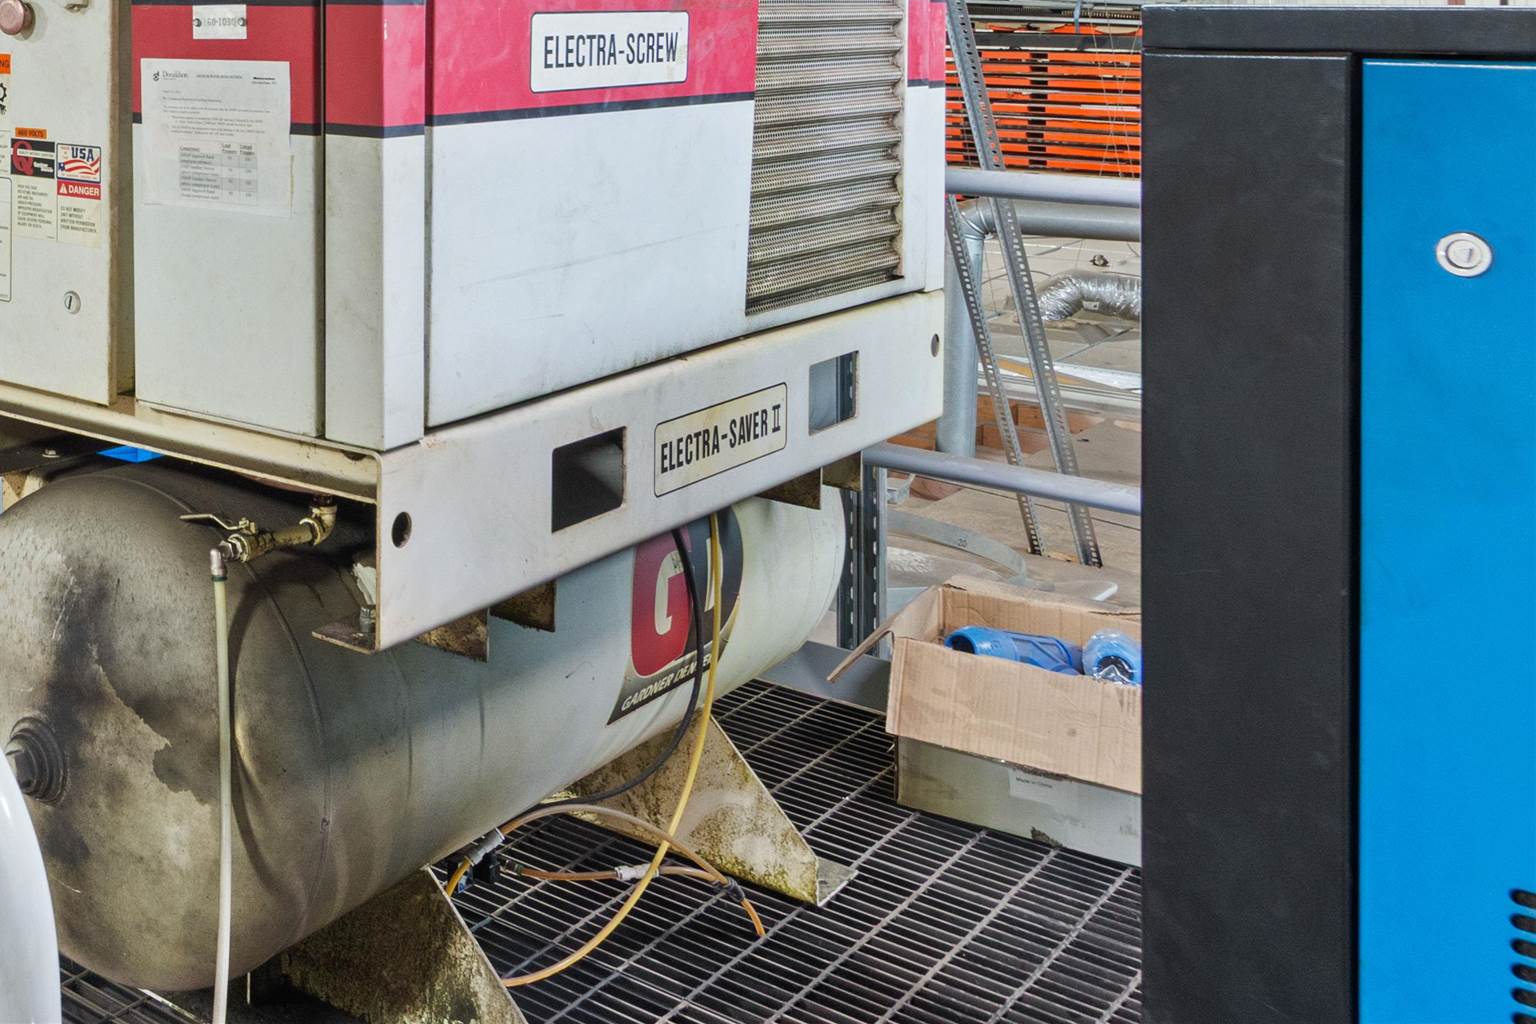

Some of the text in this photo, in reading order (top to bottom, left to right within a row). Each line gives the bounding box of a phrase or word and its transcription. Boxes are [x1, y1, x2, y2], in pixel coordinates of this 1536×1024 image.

[544, 32, 679, 69] ELECTRA-SCREW
[71, 147, 95, 162] USA
[68, 184, 100, 196] DANGER
[661, 404, 781, 474] ELECTRA-SAVER II
[621, 653, 712, 712] GARDNER DENER
